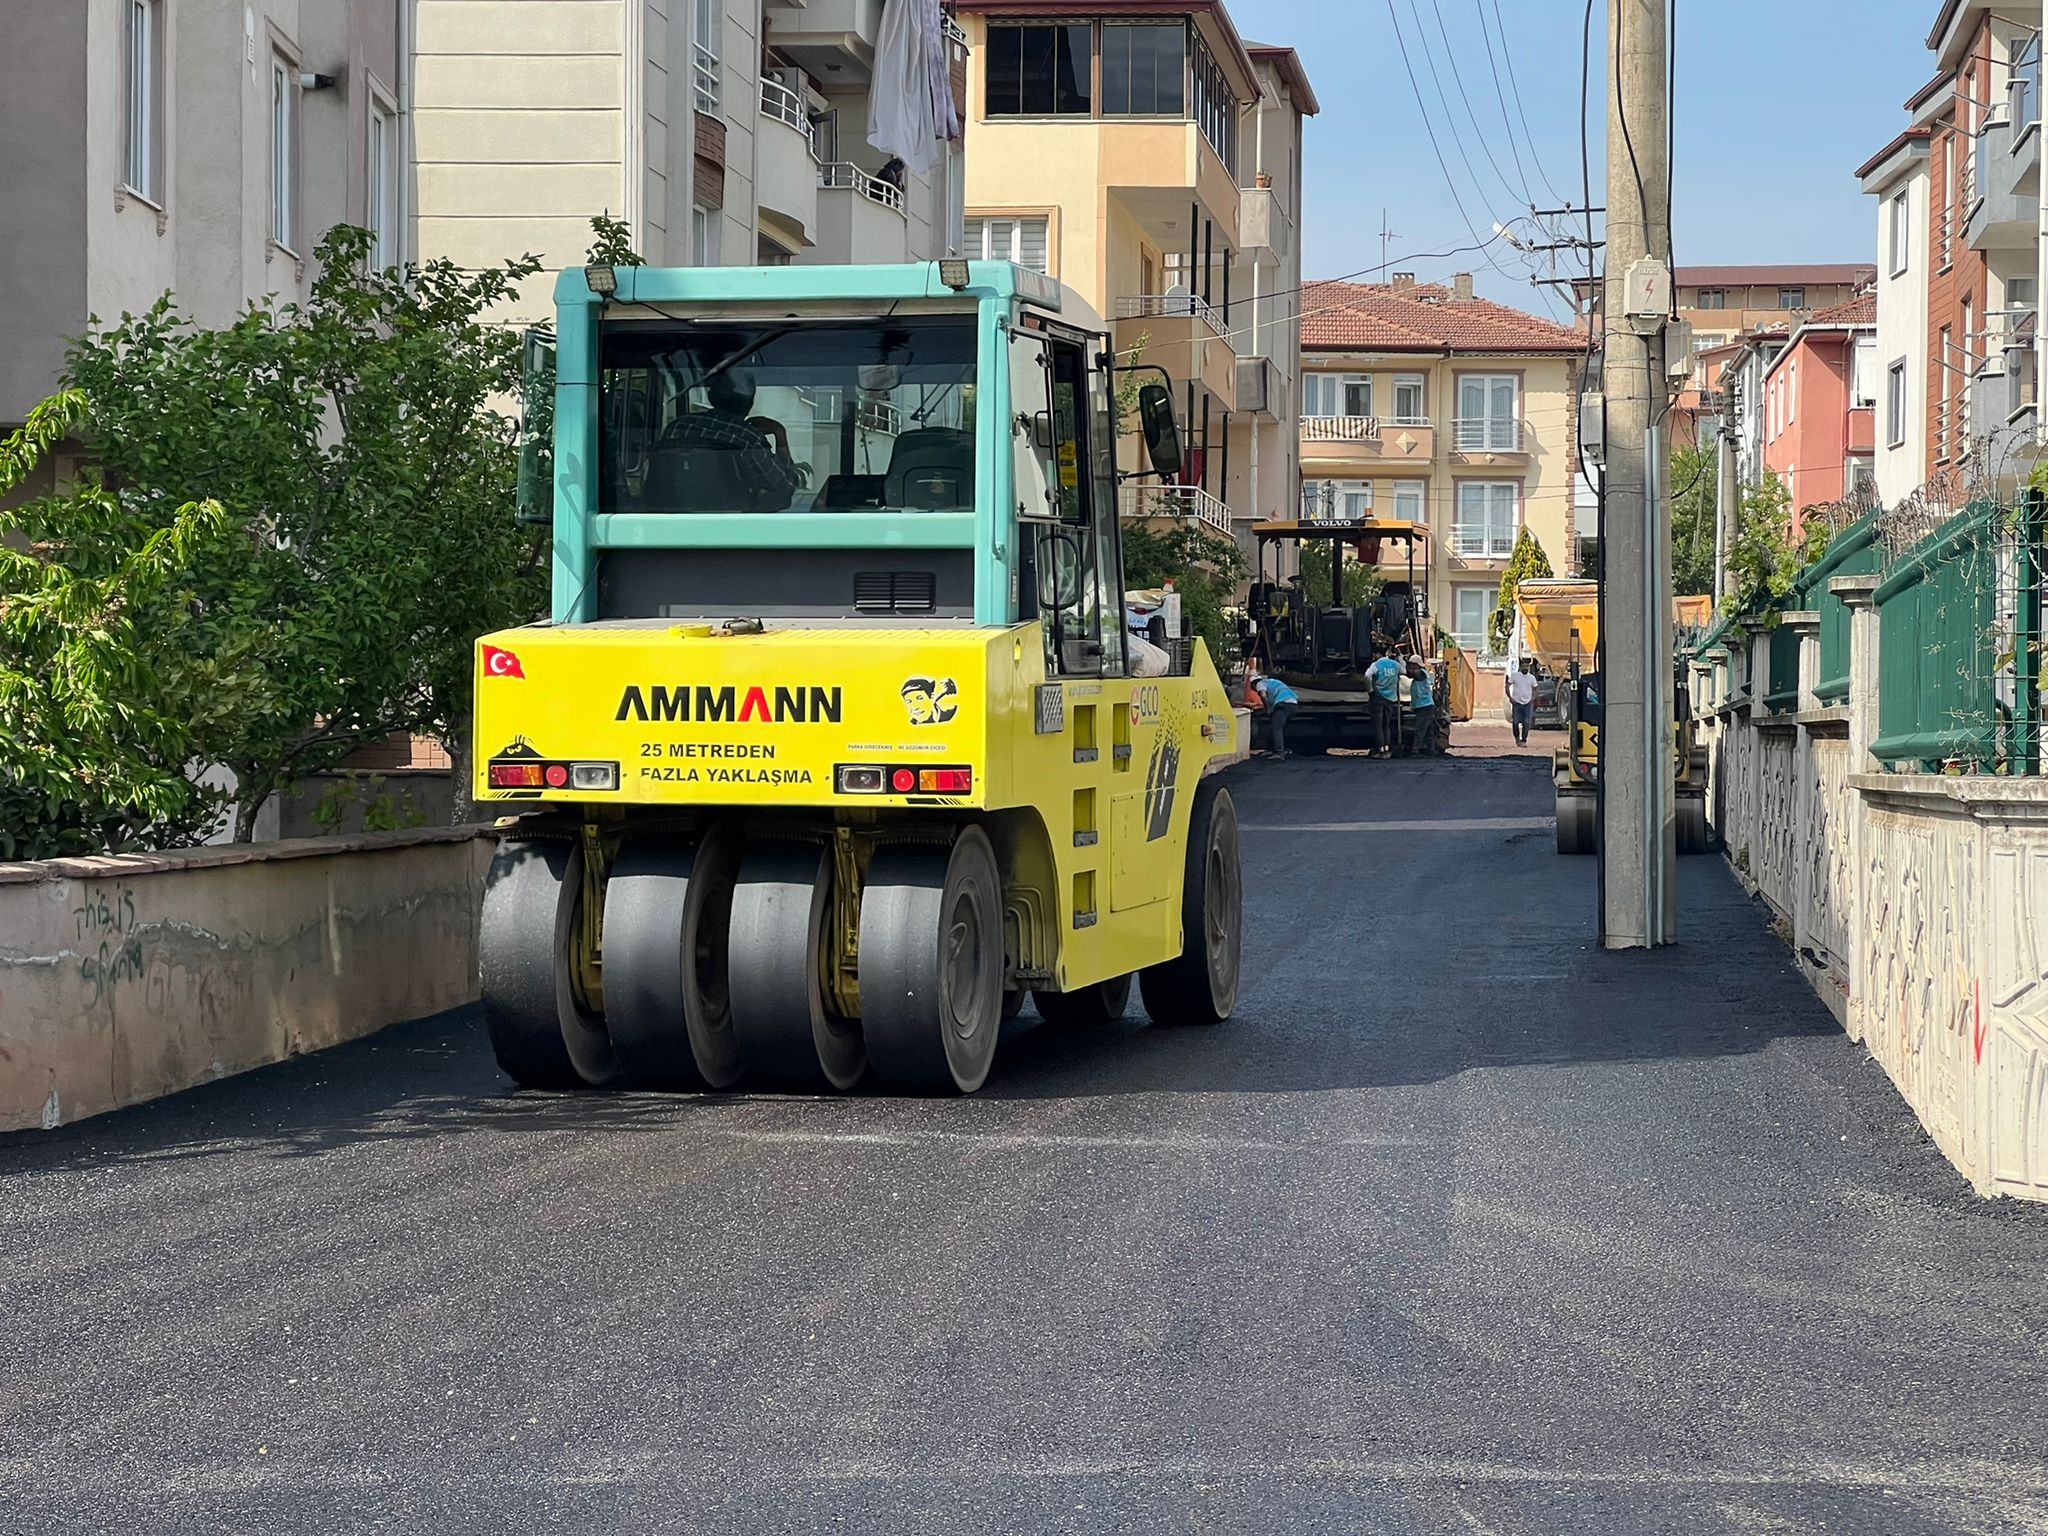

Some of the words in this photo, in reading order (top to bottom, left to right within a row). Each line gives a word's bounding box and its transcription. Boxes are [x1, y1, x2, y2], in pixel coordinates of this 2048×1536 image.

[615, 685, 842, 723] AMMANN
[640, 743, 663, 757] 25
[669, 743, 776, 759] METREDEN
[640, 767, 700, 782] FAZLA
[706, 767, 813, 787] YAKLAŞMA
